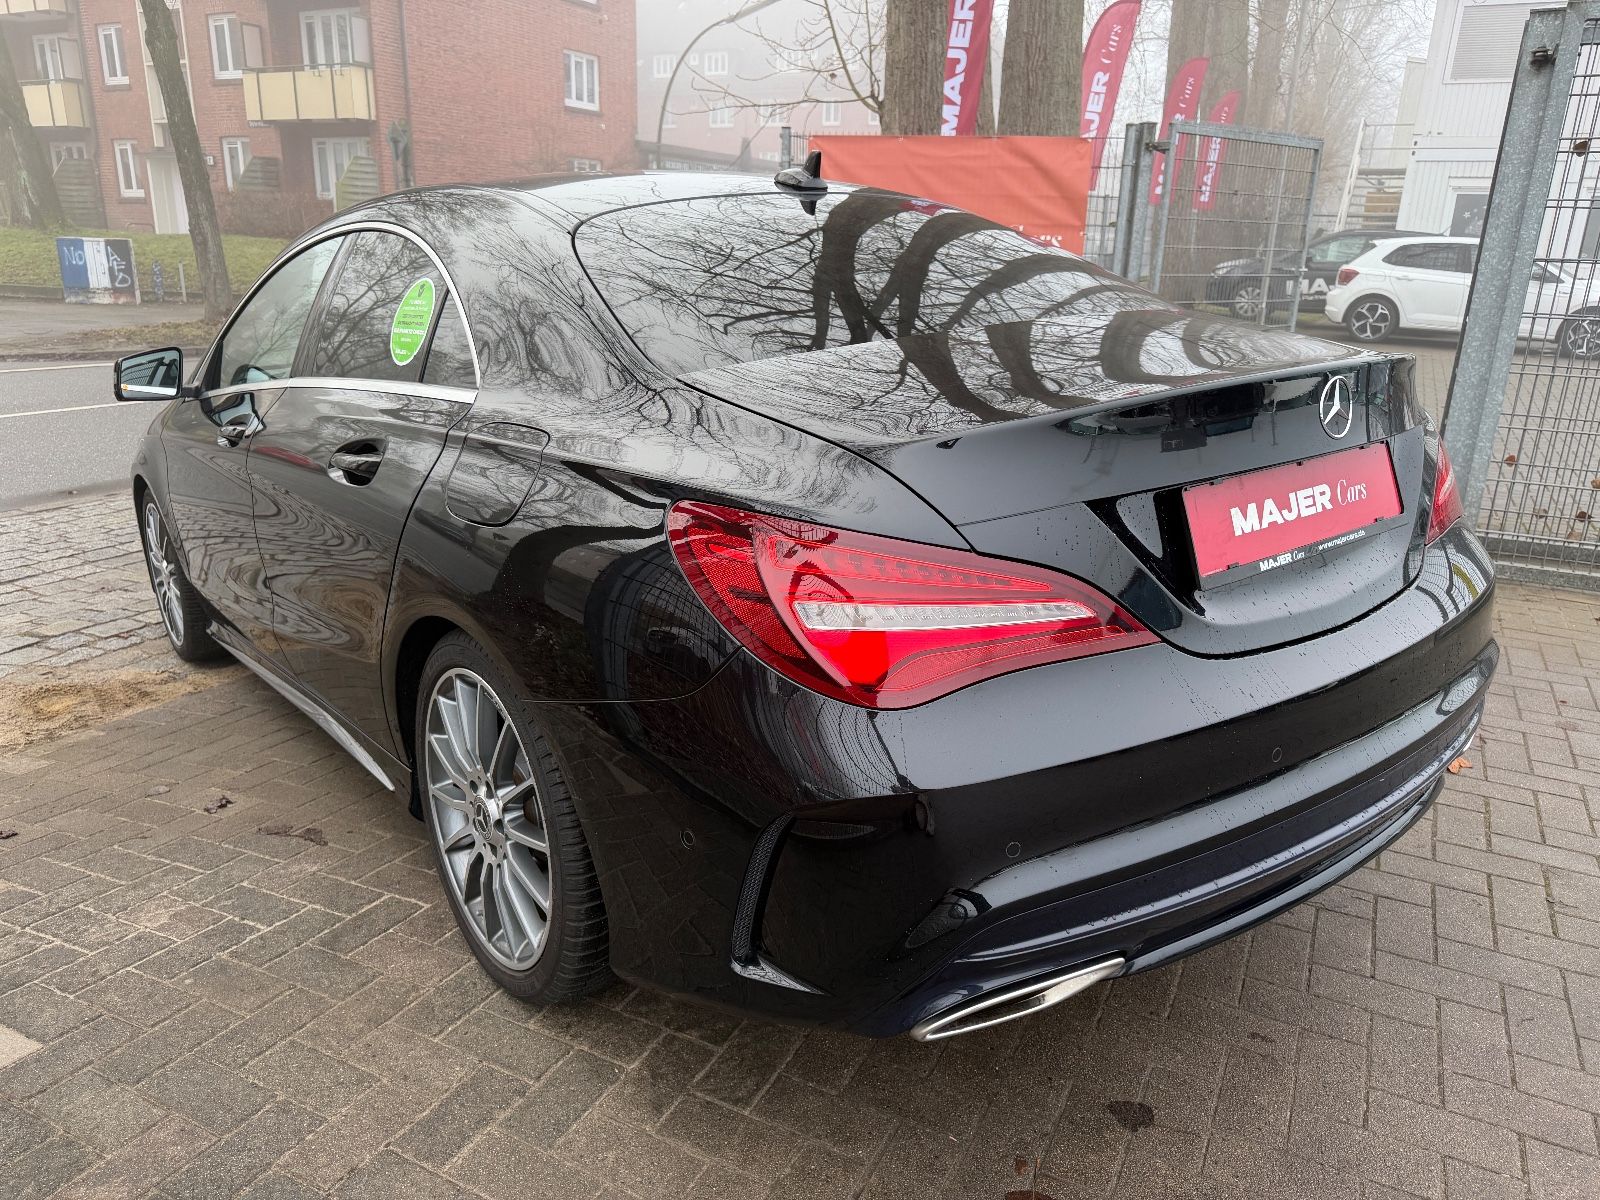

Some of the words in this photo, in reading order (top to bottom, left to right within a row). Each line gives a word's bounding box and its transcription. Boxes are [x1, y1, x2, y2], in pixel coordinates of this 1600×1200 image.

[63, 246, 85, 265] No
[1230, 484, 1333, 536] MAJER
[1337, 479, 1367, 506] Cars
[1259, 553, 1293, 571] MAJER
[1293, 550, 1305, 561] Cars
